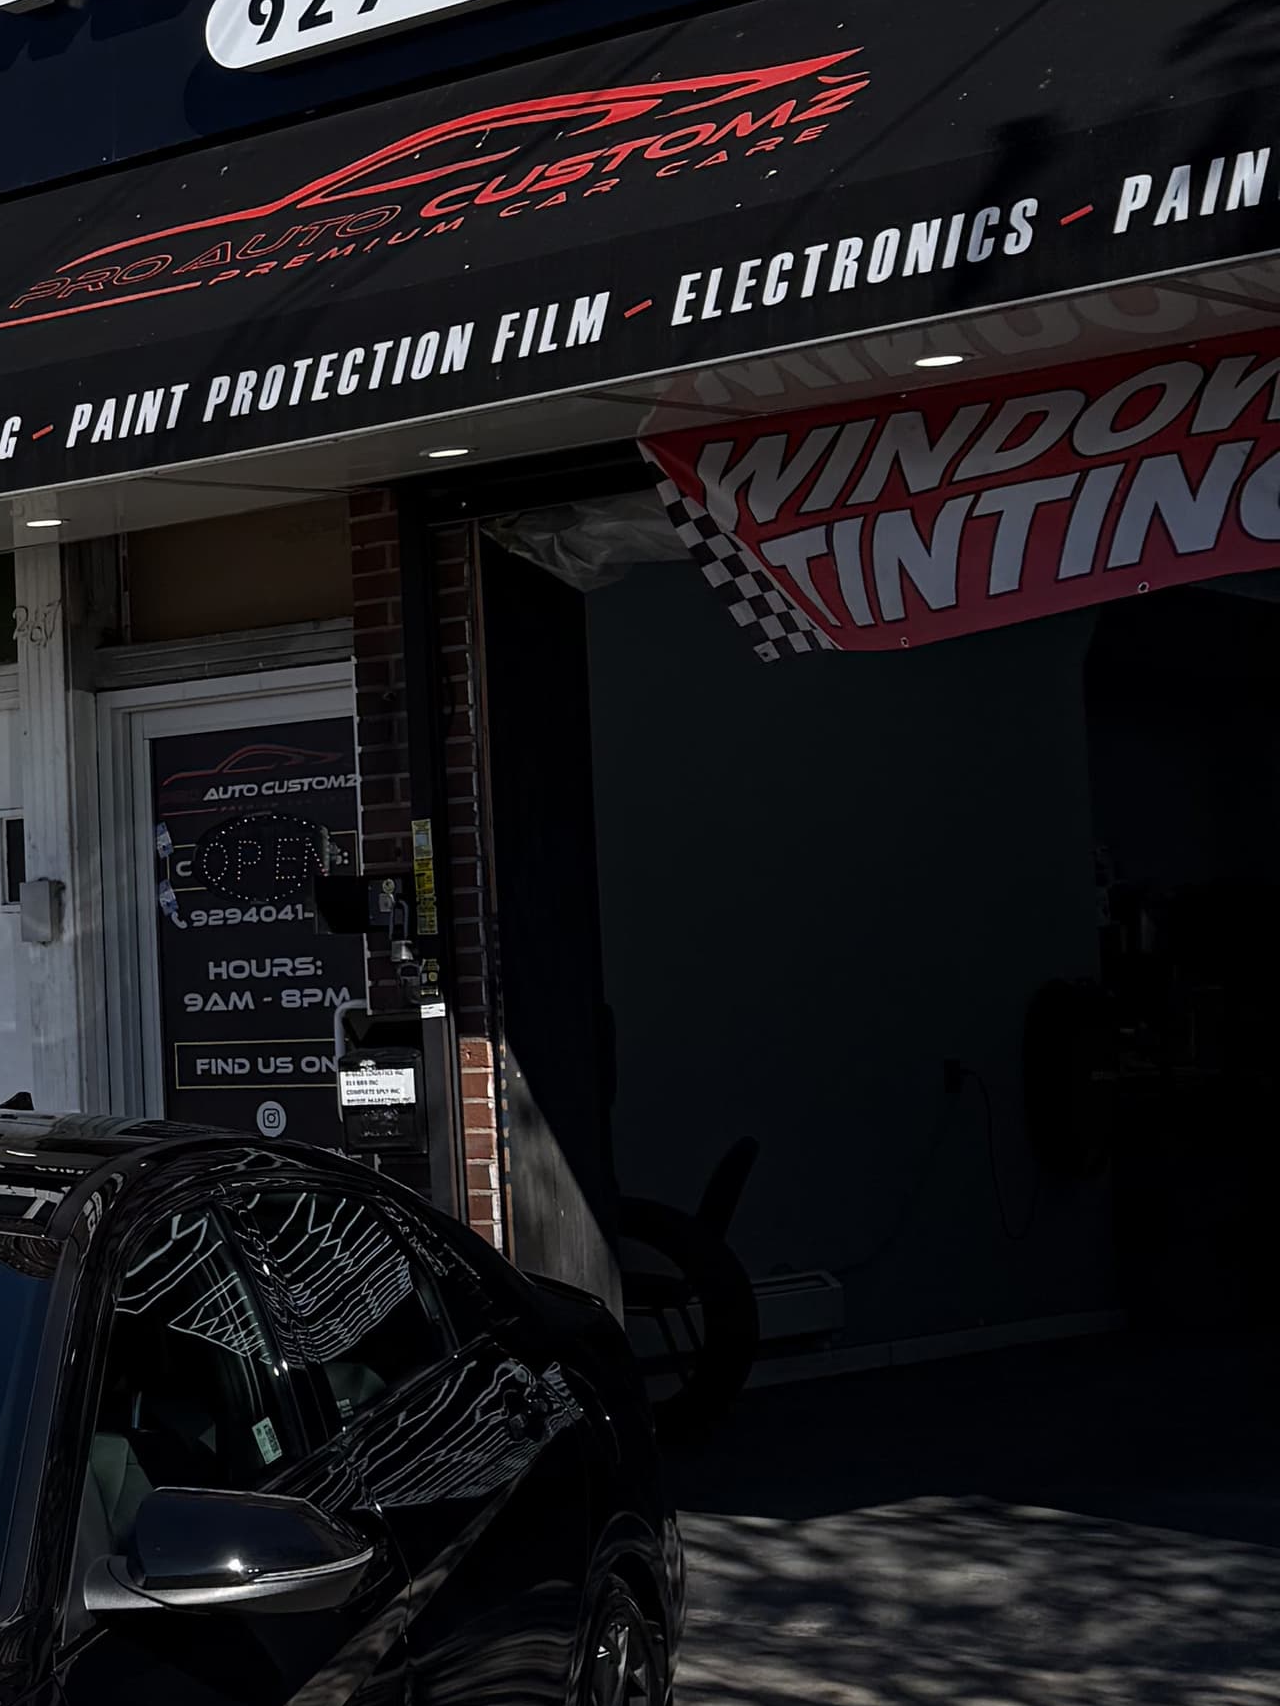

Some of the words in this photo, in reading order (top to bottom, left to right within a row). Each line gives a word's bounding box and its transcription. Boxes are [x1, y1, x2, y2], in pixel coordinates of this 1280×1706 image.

[10, 253, 174, 310] PRO
[177, 205, 401, 273] AUTO
[418, 70, 871, 218] CUSTOMZ
[207, 217, 465, 285] PREMIUM
[498, 179, 616, 220] CAR
[657, 122, 827, 180] CARE
[66, 384, 189, 449] PAINT
[204, 321, 474, 423] PROTECTION
[490, 292, 611, 364] FILM
[671, 196, 1040, 327] ELECTRONICS
[203, 784, 258, 801] AUTO
[203, 837, 328, 883] OPEN
[208, 957, 323, 980] HOURS:
[184, 991, 255, 1012] 9AM
[281, 987, 350, 1008] 8PM
[196, 1058, 250, 1075] FIND
[258, 1057, 294, 1073] US
[301, 1055, 337, 1072] ON
